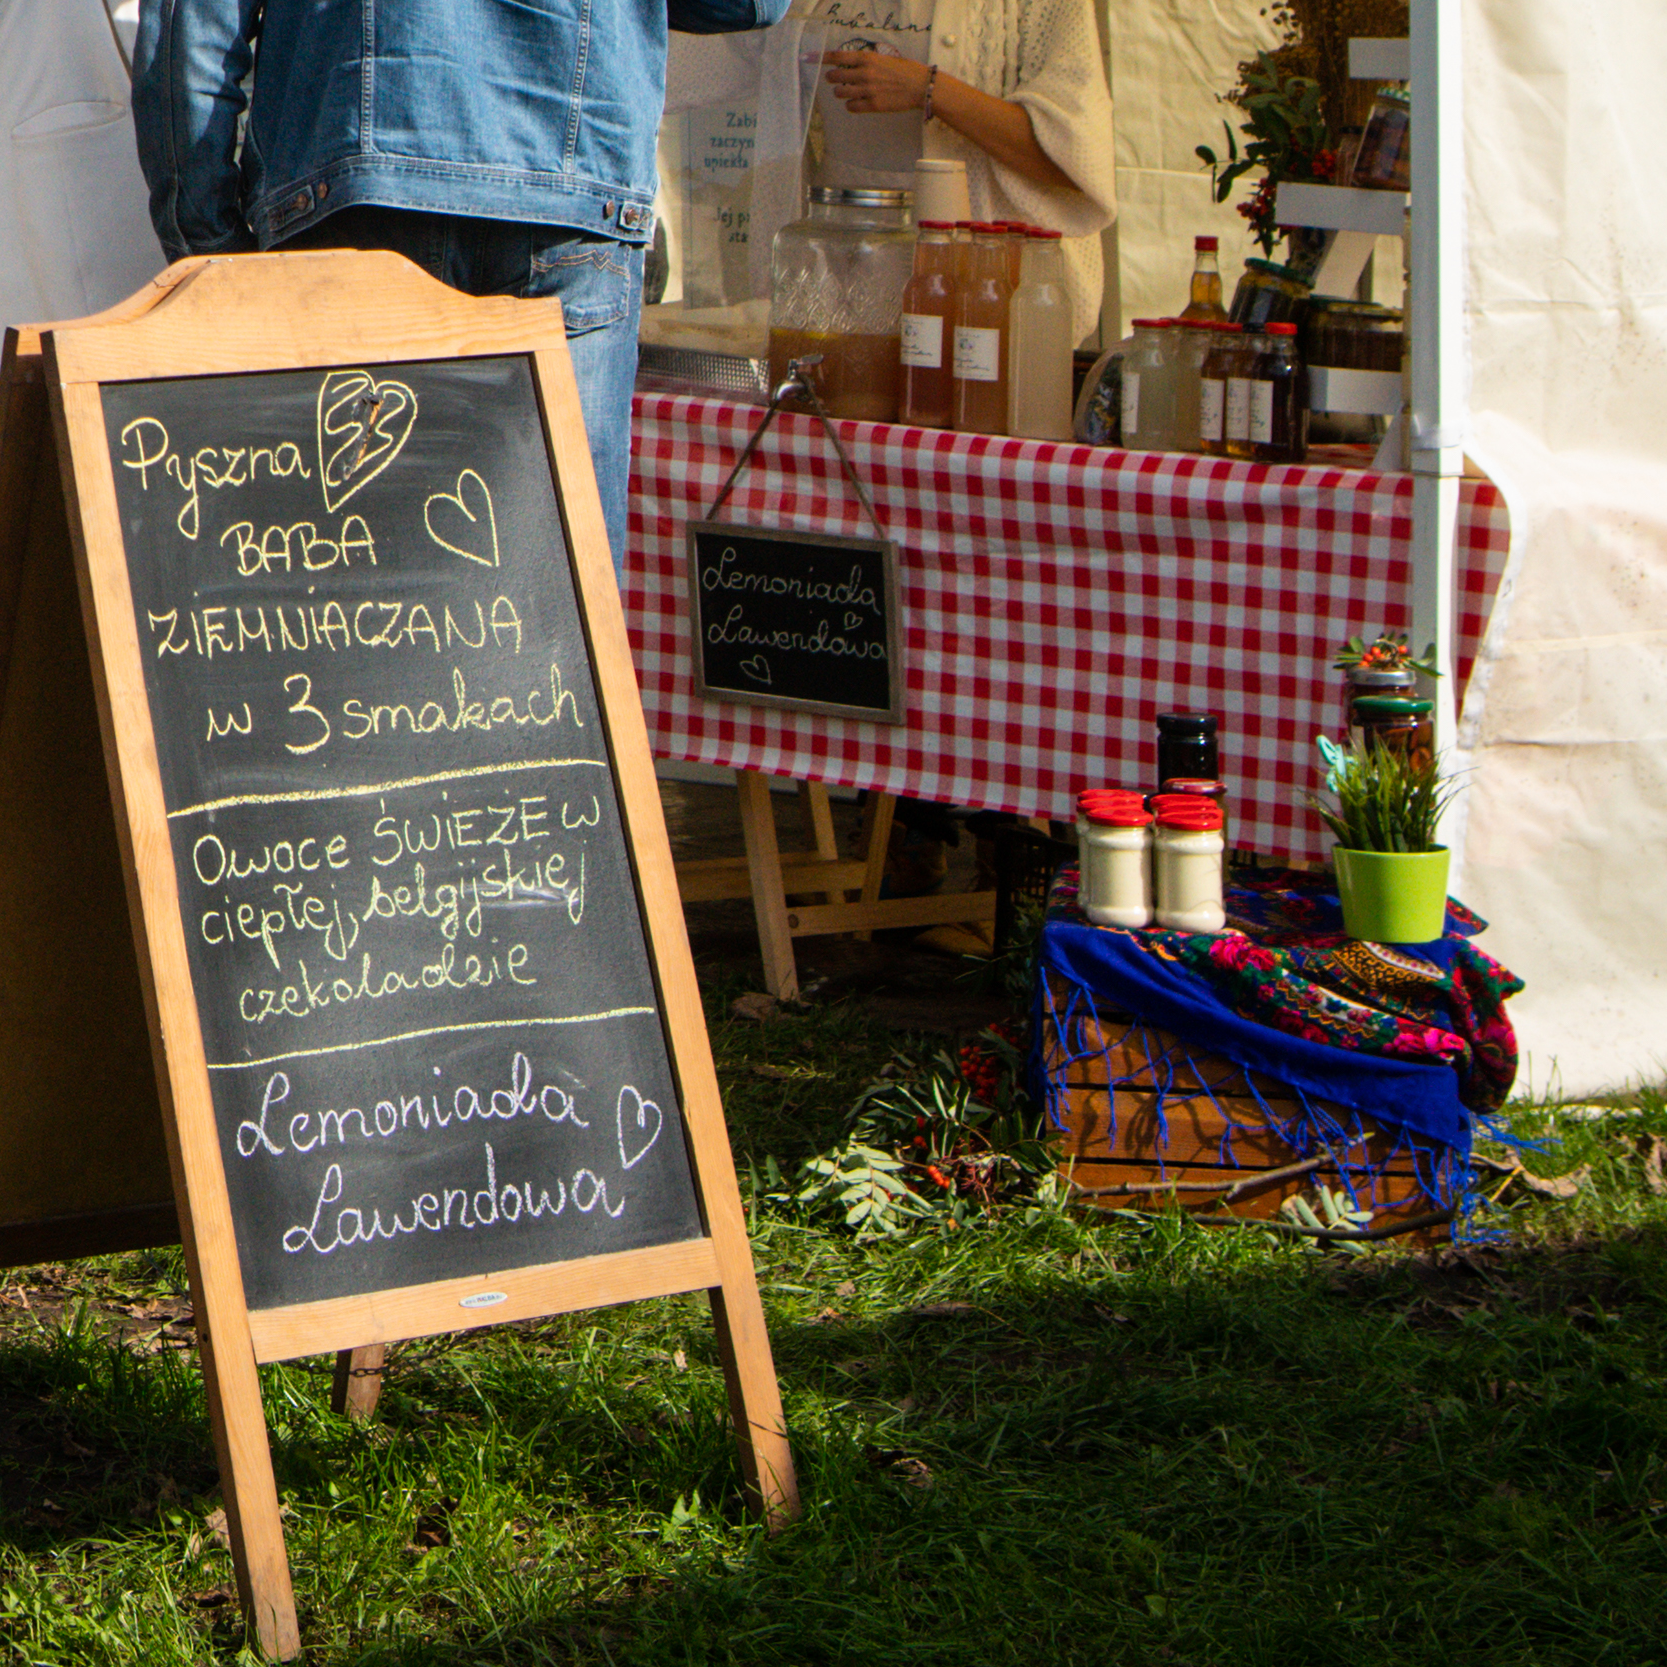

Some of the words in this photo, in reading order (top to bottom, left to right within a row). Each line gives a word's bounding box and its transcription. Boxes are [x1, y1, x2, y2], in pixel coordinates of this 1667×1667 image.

[121, 417, 311, 540] Pyszna
[220, 515, 377, 576] BABA
[702, 546, 882, 616] Lemoniada
[708, 604, 888, 660] Lawendowa
[283, 674, 331, 754] 3
[343, 663, 584, 739] smakach
[193, 834, 351, 885] Owoce
[239, 938, 538, 1024] czekoladzie
[237, 1052, 590, 1157] Lemoniada
[283, 1142, 626, 1253] Lawendowa
